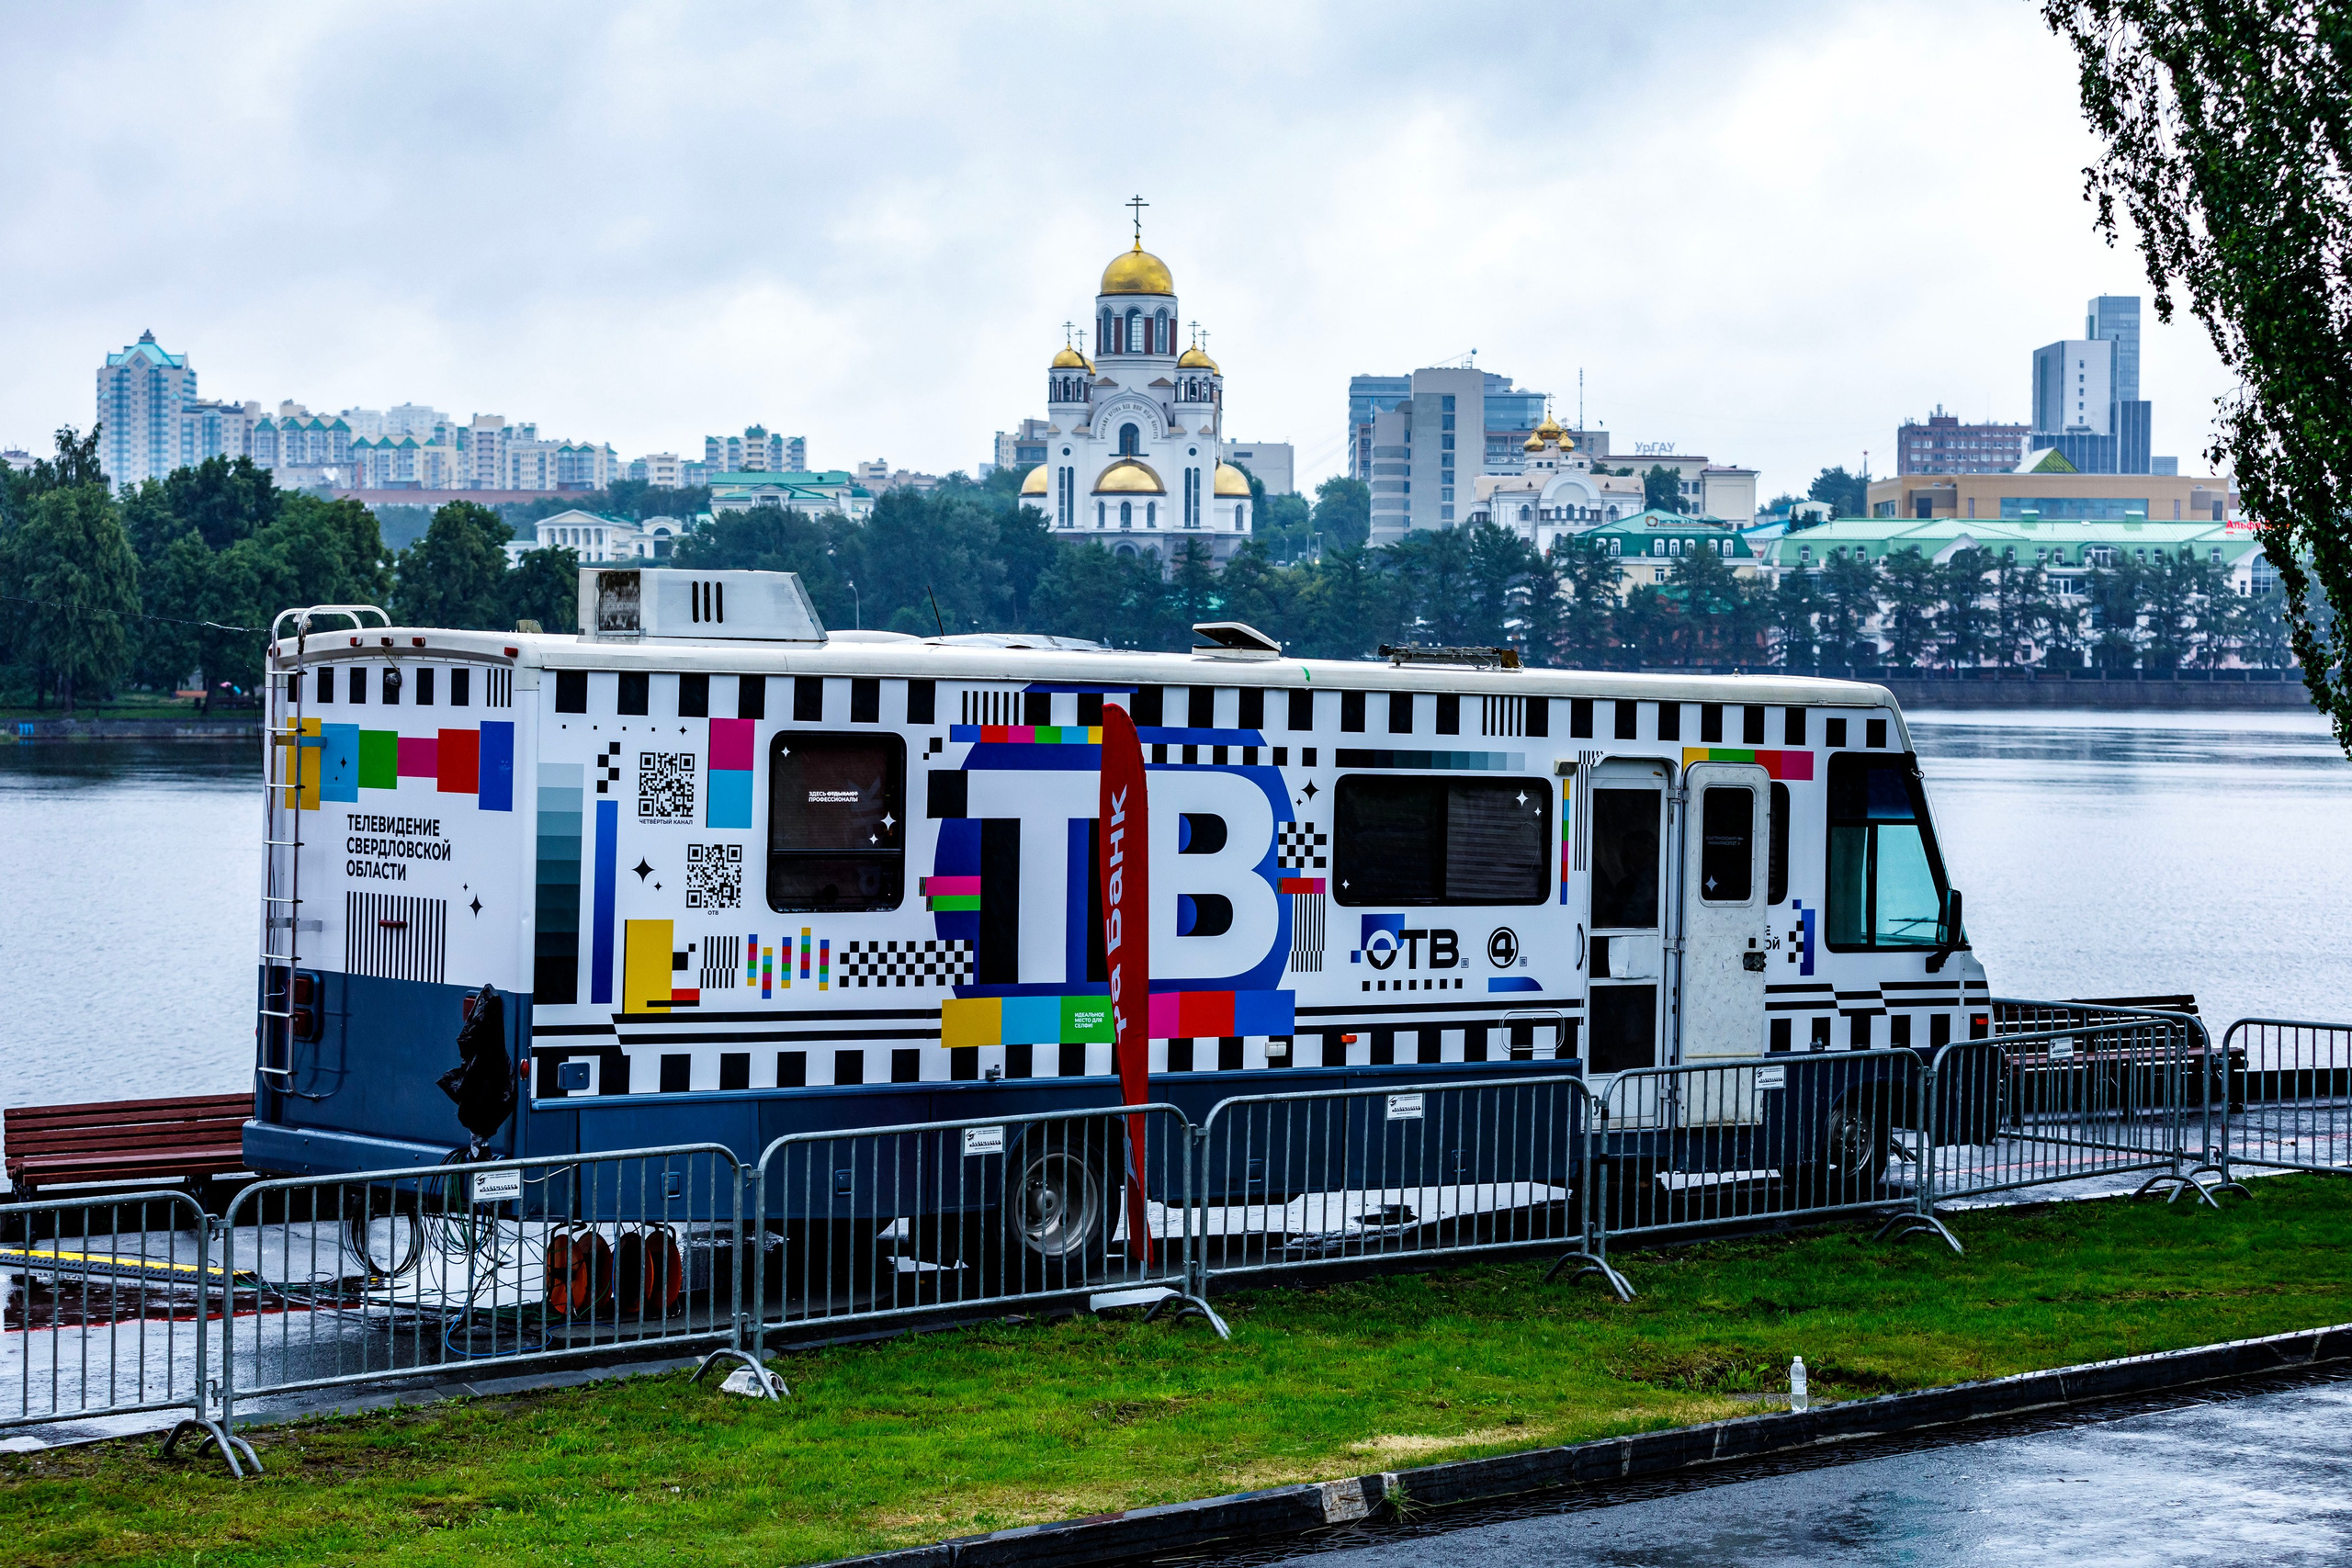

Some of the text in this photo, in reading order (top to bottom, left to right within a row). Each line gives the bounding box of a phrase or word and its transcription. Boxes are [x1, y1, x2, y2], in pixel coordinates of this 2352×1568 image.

[1634, 441, 1676, 453] УрГАУ
[346, 813, 440, 838] ТЕЛЕВИДЕНИЕ
[346, 837, 451, 862] СВЕРДЛОВСКОЙ
[346, 859, 407, 881] ОБЛАСТИ
[1106, 784, 1127, 956] Банк
[1366, 929, 1459, 970] ОТВ
